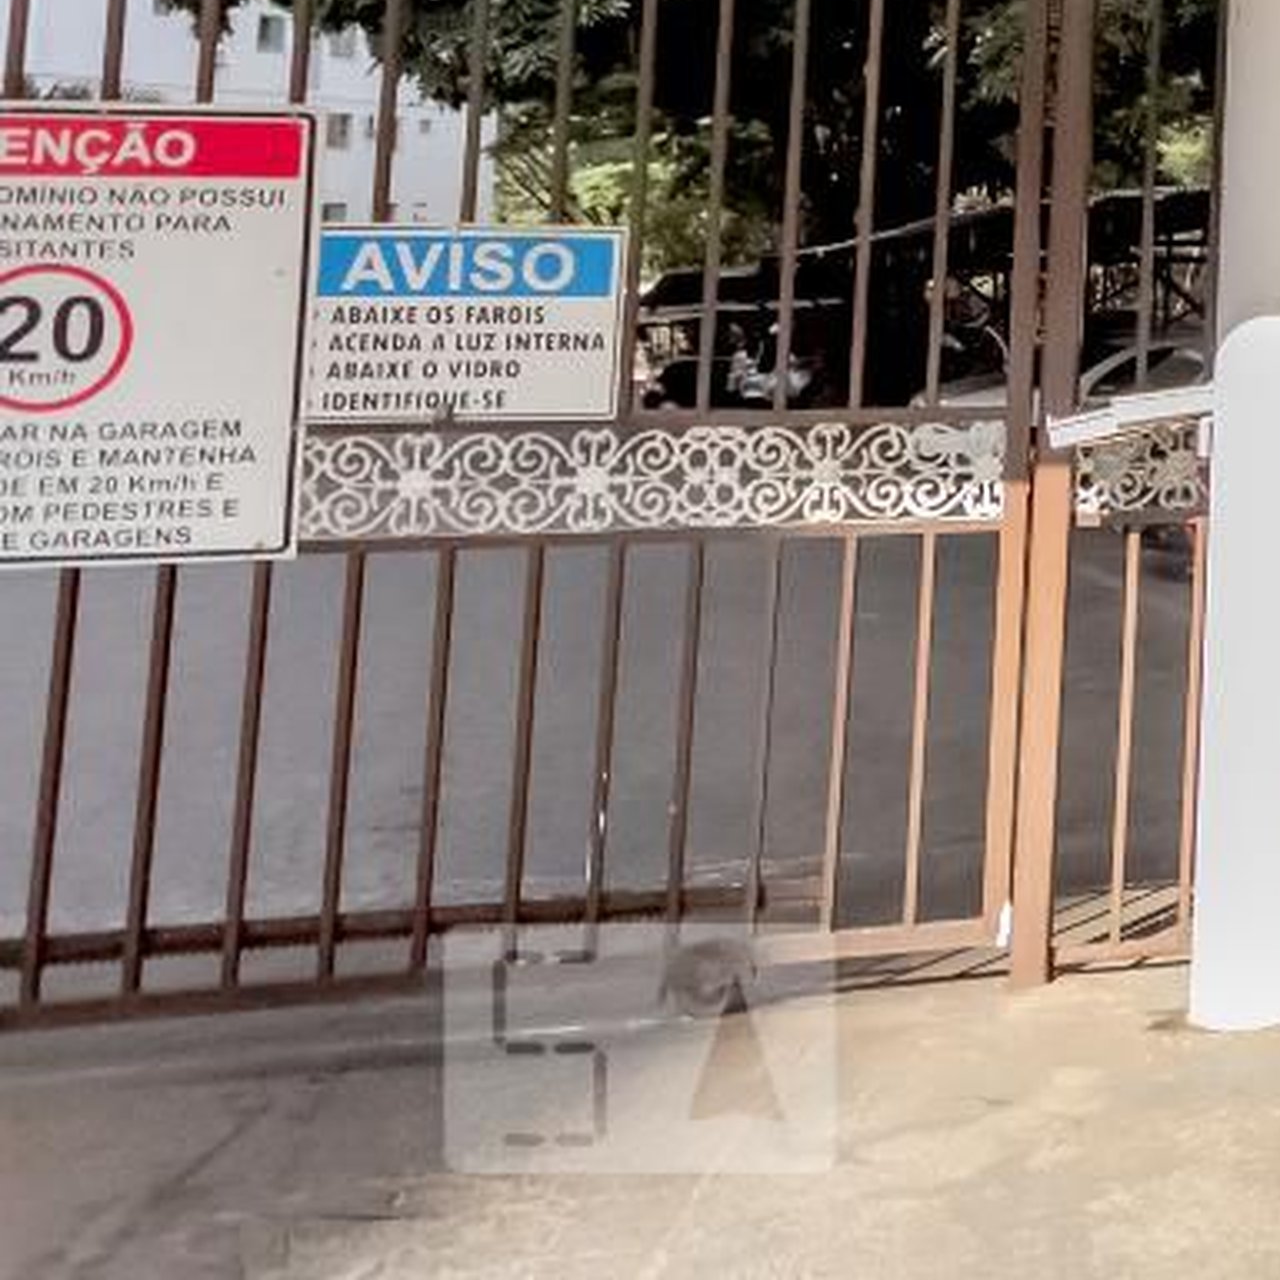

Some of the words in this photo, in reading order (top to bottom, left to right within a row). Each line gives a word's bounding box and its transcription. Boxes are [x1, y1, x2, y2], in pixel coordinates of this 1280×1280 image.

[0, 121, 196, 174] ENÇÃO
[179, 187, 286, 208] POSSUI
[155, 213, 232, 233] PARA
[341, 241, 576, 292] AVISO
[331, 305, 418, 325] ABAIXE
[426, 305, 455, 325] OS
[0, 295, 105, 363] 20
[328, 332, 423, 352] ACENDA
[432, 333, 445, 352] A
[455, 332, 498, 352] LUZ
[505, 332, 605, 352] INTERNA
[326, 360, 411, 380] ABAIXE
[422, 360, 438, 378] O
[450, 360, 522, 379] VIDRO
[322, 389, 508, 412] IDENTIFIQUE-SE
[49, 421, 88, 442] NA
[99, 419, 242, 441] GARAGEM
[72, 449, 88, 468] E
[99, 444, 257, 467] MANTENHA
[39, 475, 79, 497] EM
[89, 476, 118, 495] 20
[206, 472, 224, 492] E
[43, 497, 213, 522] PEDESTRES
[223, 498, 239, 518] E
[29, 525, 193, 551] GARAGENS
